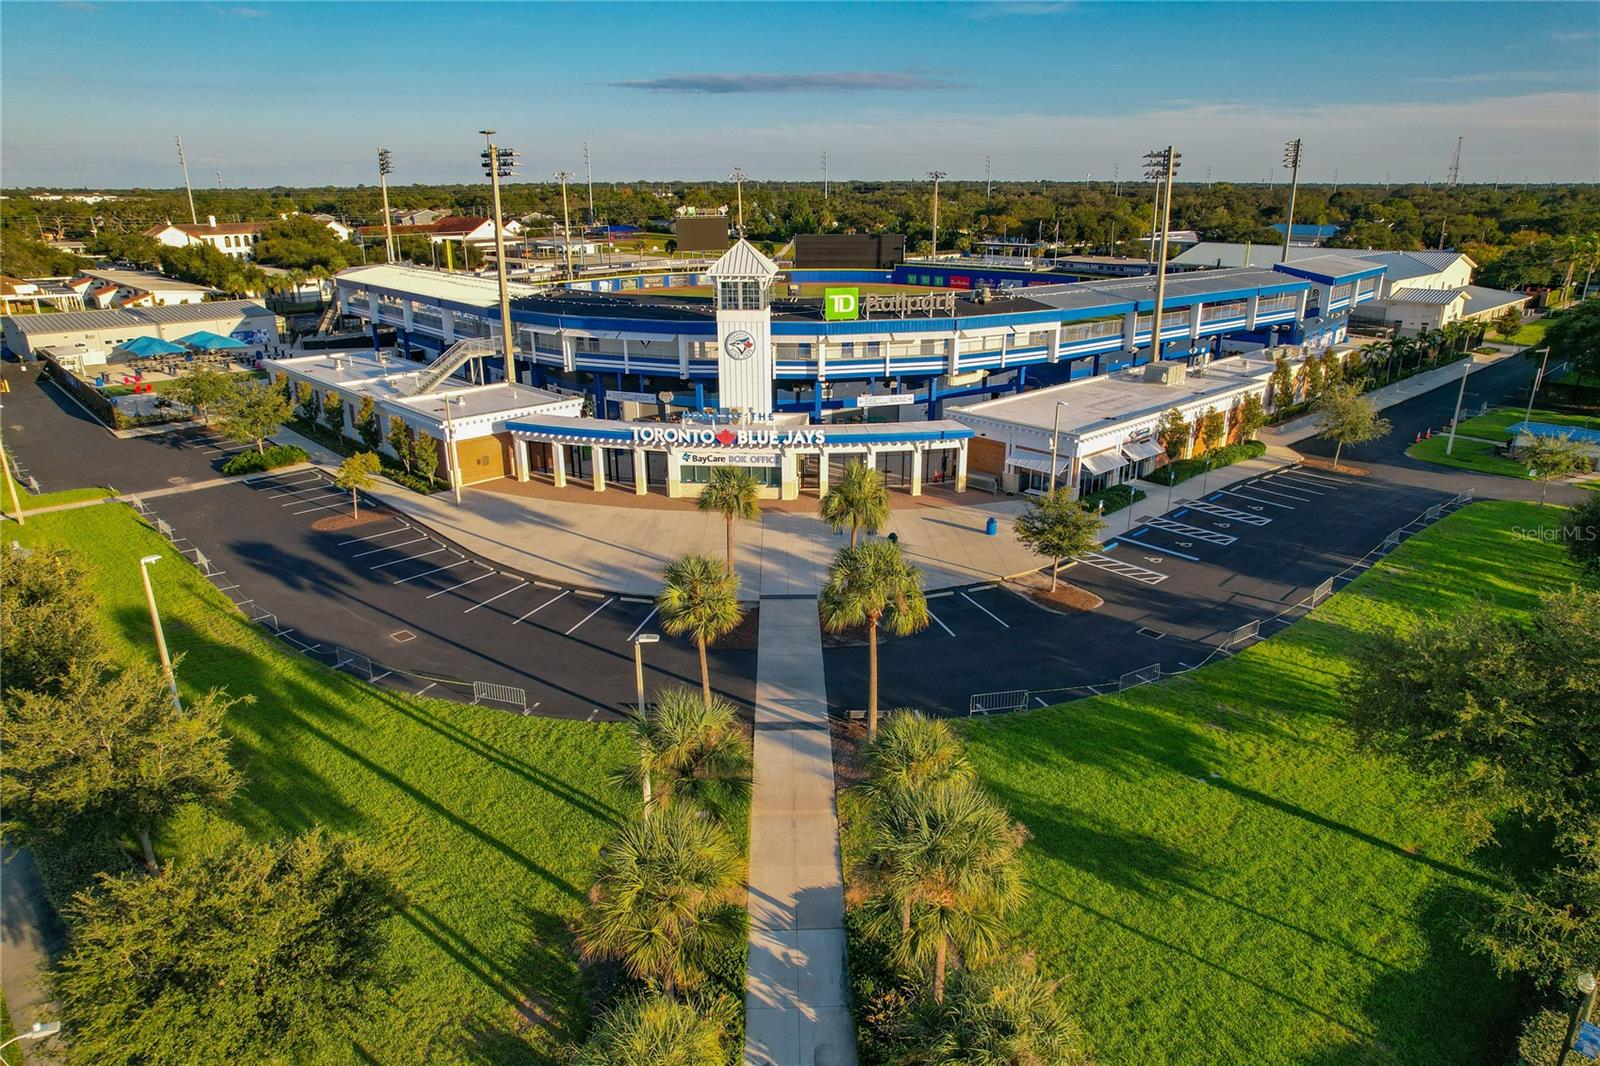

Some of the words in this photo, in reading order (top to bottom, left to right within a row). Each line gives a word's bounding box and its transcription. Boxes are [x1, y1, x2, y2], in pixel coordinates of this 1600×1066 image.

[828, 294, 855, 313] TD
[866, 291, 956, 314] Ballpark
[751, 411, 774, 421] THE
[630, 426, 715, 444] TORONTO
[737, 430, 779, 445] BLUE
[782, 429, 826, 445] JAYS
[692, 454, 726, 464] BayCare
[728, 455, 747, 463] BOX
[749, 455, 780, 464] OFFICE
